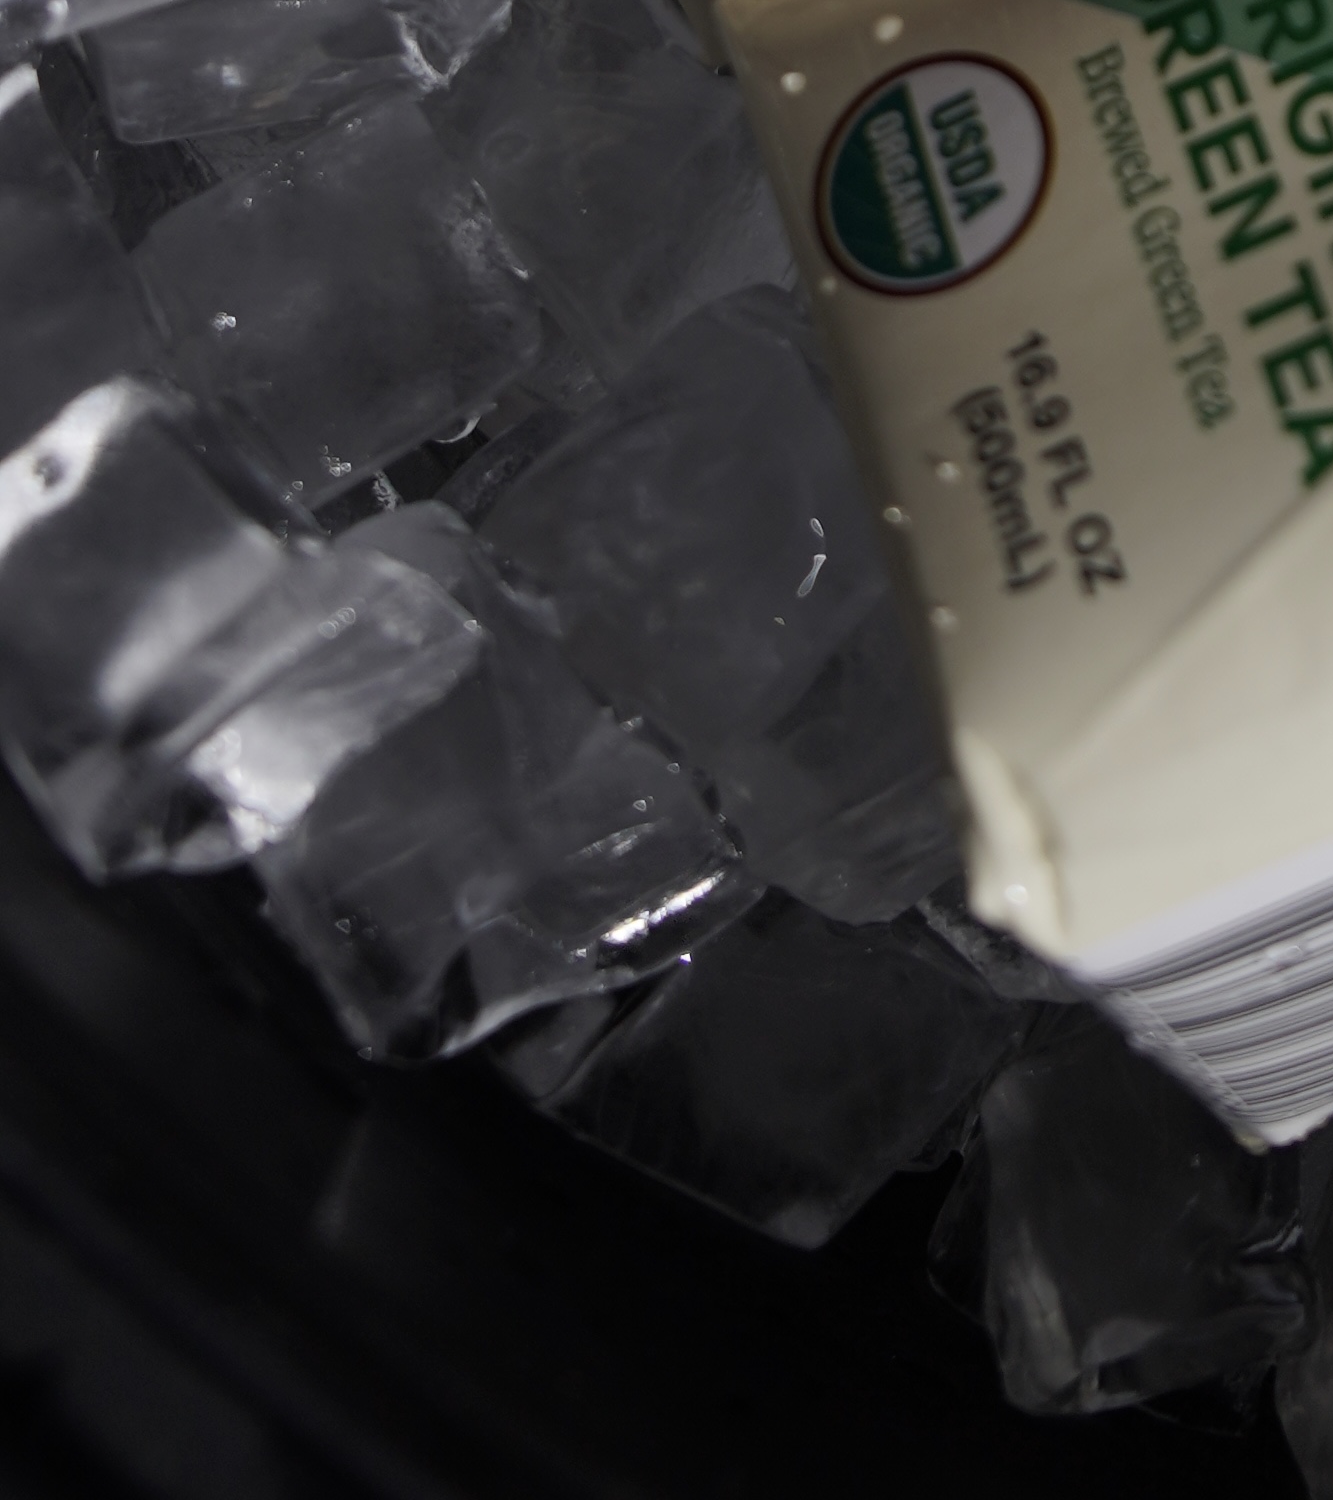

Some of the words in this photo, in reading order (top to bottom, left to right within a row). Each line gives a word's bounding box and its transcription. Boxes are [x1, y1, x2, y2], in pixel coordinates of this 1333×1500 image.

[866, 108, 941, 270] ORGANIC
[930, 91, 1006, 223] USDA
[1079, 42, 1170, 209] Brewed
[1133, 201, 1208, 344] Green
[1177, 333, 1236, 433] Tea
[1007, 329, 1072, 438] 16.9
[953, 384, 1056, 594] (500mL)
[1039, 434, 1097, 509] FL
[1066, 514, 1128, 600] OZ
